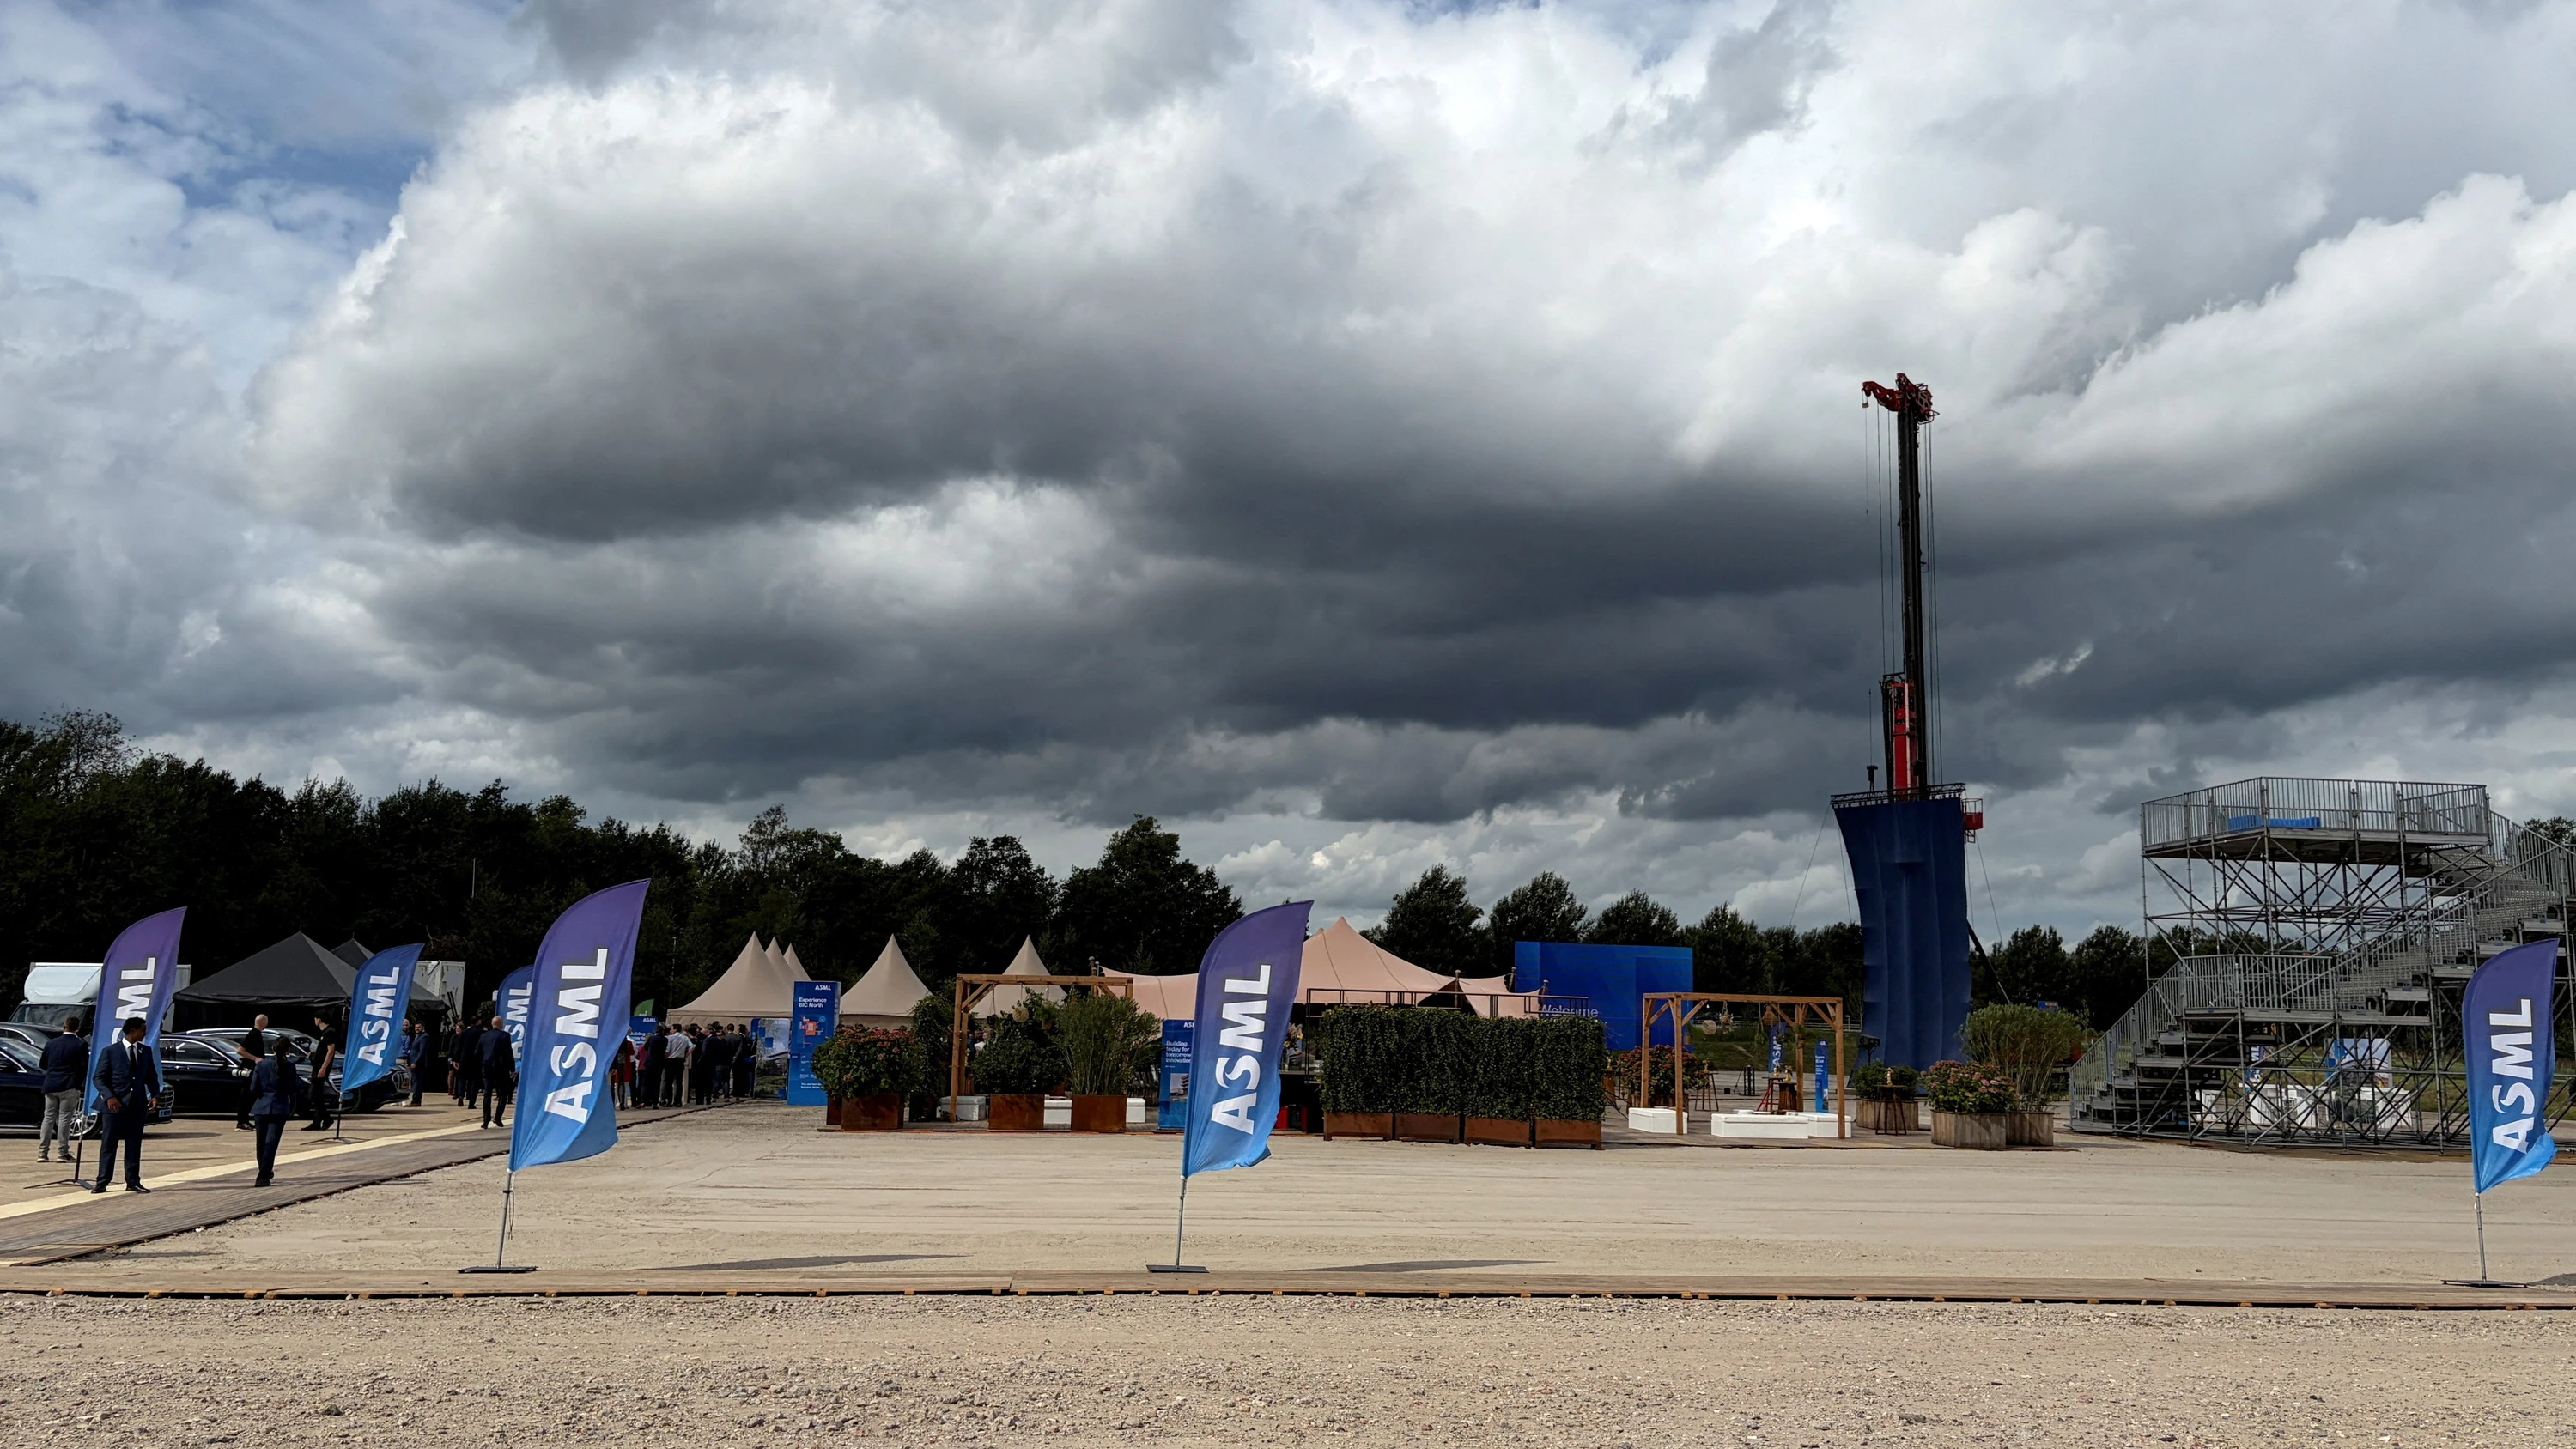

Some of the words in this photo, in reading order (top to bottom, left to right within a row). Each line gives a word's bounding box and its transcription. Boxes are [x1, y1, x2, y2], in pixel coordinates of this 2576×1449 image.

[358, 967, 399, 1066] ASML
[544, 948, 608, 1124] ASML
[1211, 964, 1271, 1135] ASML
[2489, 997, 2536, 1155] ASML
